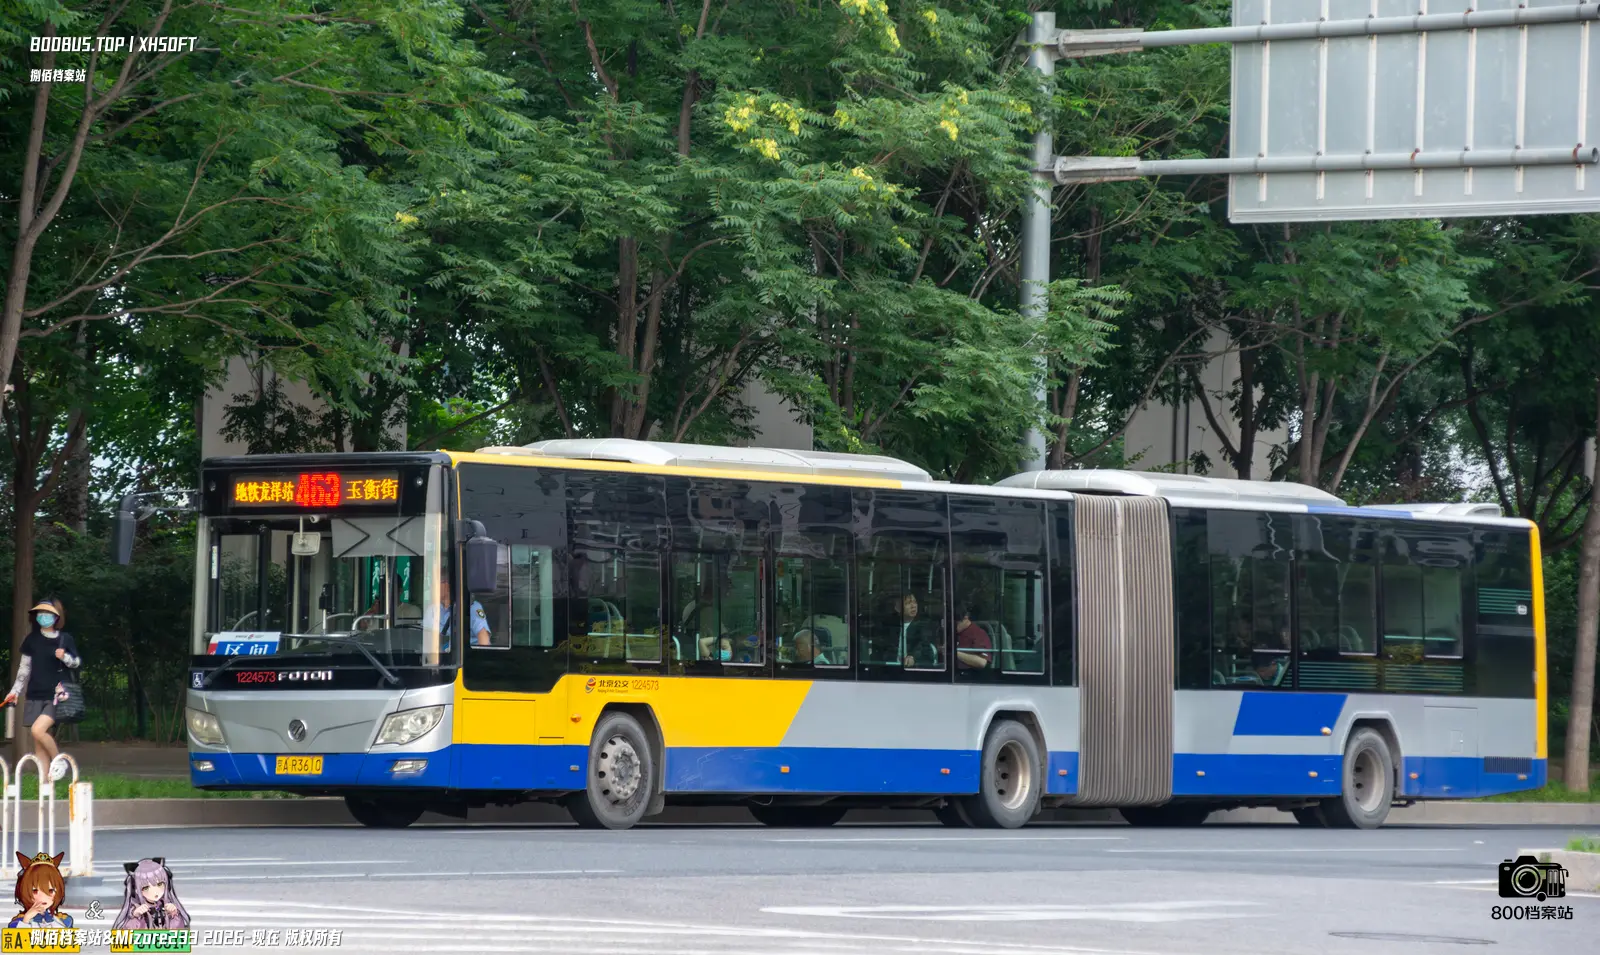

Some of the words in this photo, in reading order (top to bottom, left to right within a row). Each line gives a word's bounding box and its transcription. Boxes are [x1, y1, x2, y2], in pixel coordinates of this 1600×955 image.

[296, 472, 342, 506] 463
[346, 478, 399, 501] 玉衡街
[236, 671, 277, 683] 1224573
[599, 679, 629, 688] 北京公交
[631, 679, 659, 691] 1224573
